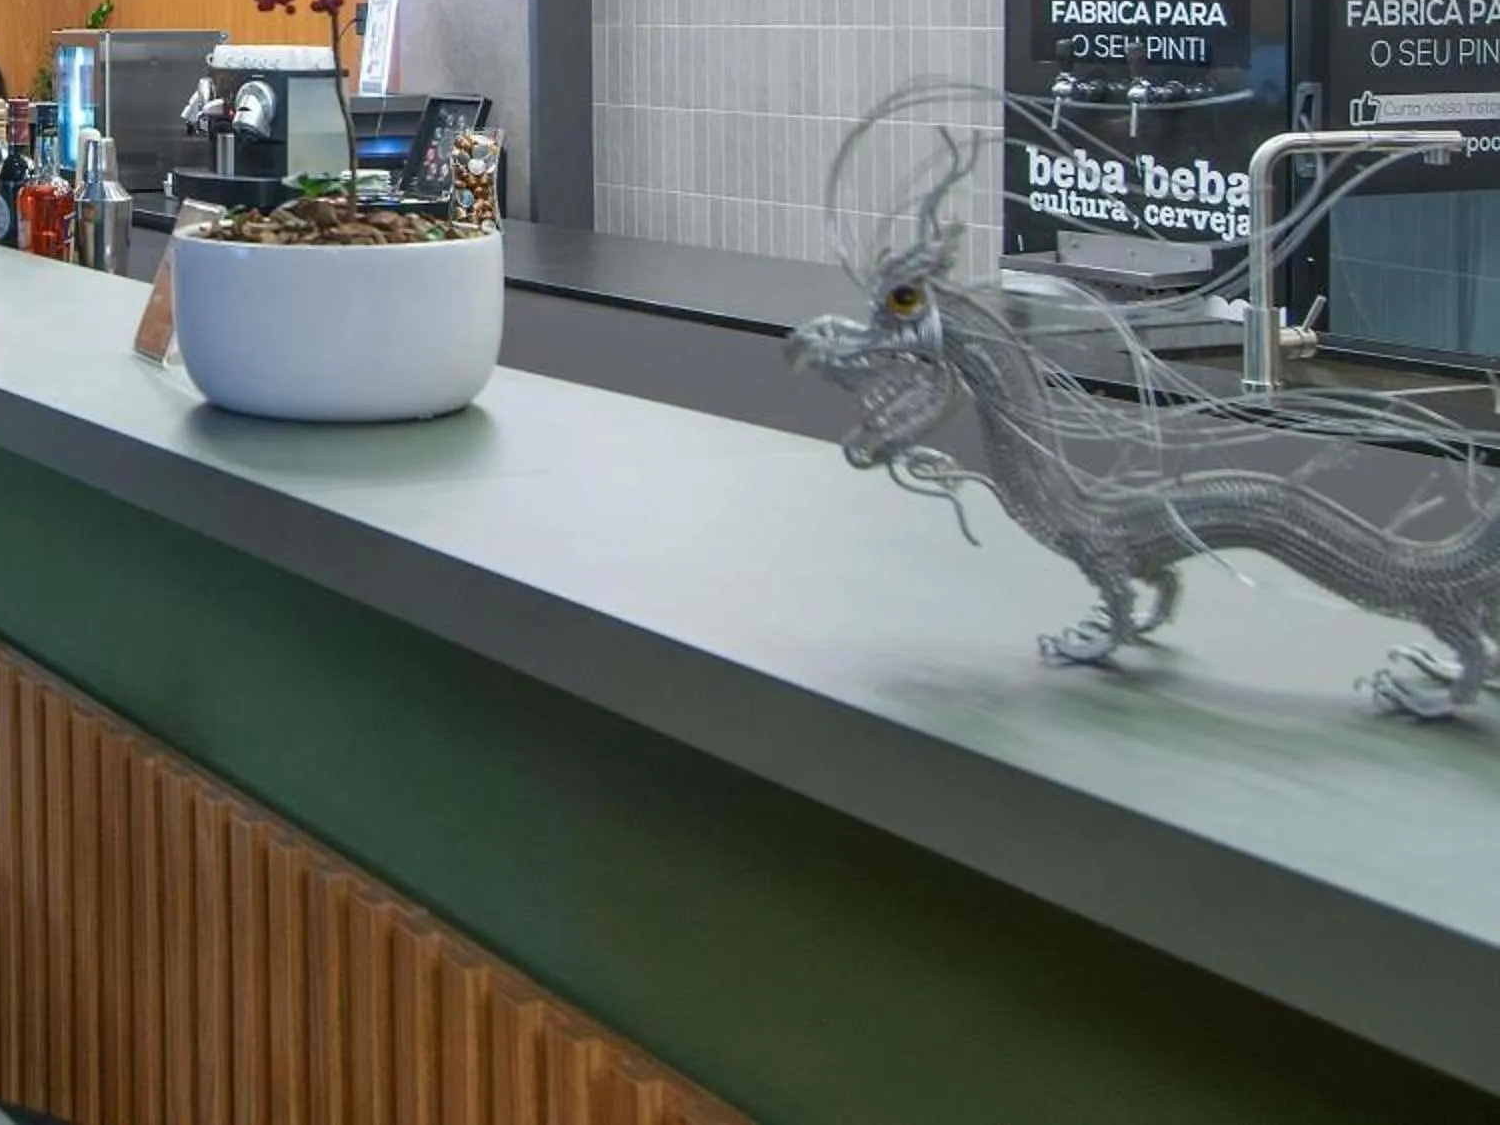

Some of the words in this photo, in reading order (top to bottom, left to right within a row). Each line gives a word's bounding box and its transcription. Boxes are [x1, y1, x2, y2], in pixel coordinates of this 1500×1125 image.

[1155, 1, 1227, 26] PARA
[1072, 34, 1089, 57] O
[1147, 36, 1206, 61] PINT!
[1371, 40, 1391, 67] O
[1399, 38, 1451, 67] SEU
[1026, 145, 1127, 194] beba
[1144, 202, 1250, 242] cerveja
